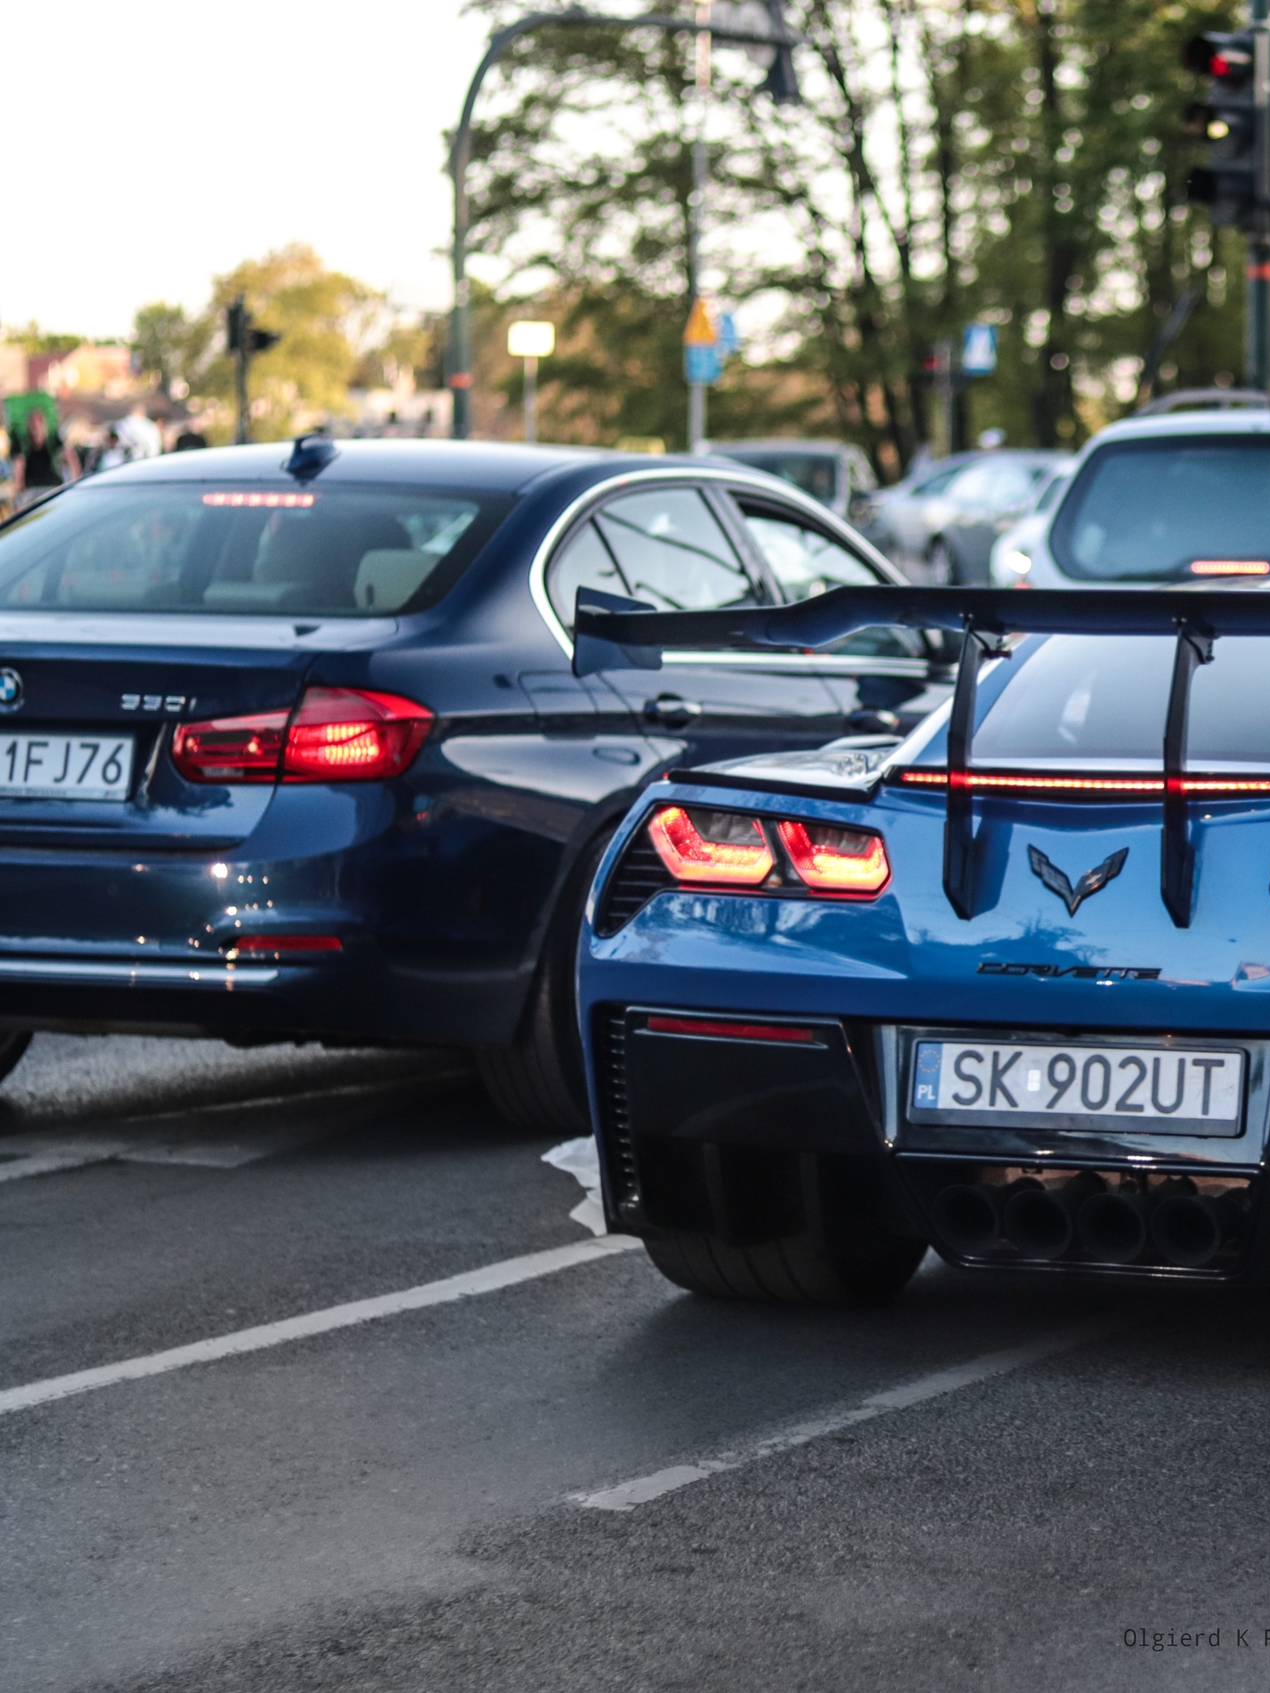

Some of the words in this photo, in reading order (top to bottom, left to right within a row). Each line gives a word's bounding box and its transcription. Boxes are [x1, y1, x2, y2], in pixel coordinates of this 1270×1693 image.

[976, 962, 1162, 980] CORVETTE
[917, 1084, 936, 1100] PL
[952, 1050, 1023, 1108] SK
[1046, 1053, 1225, 1116] 902UT
